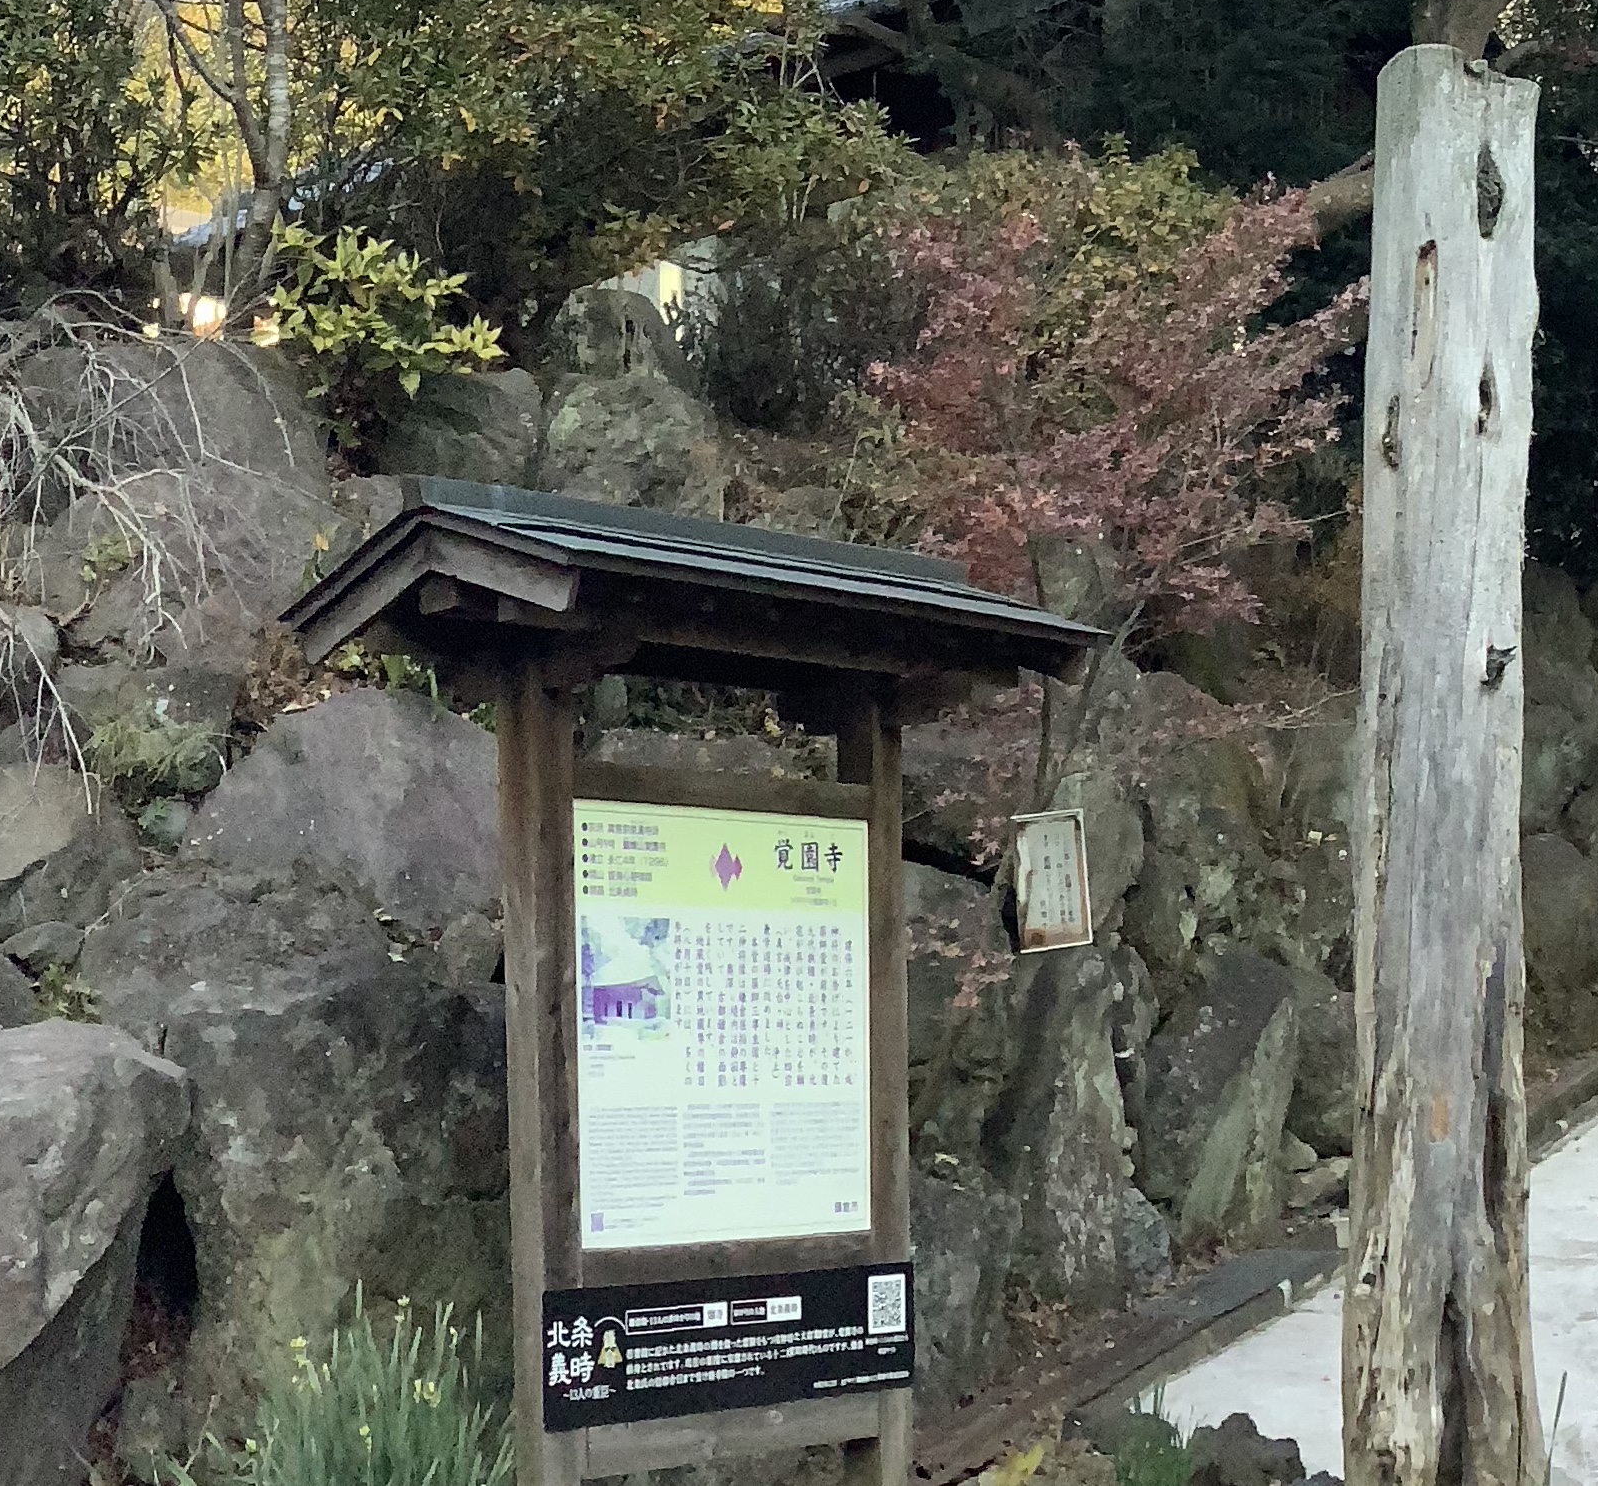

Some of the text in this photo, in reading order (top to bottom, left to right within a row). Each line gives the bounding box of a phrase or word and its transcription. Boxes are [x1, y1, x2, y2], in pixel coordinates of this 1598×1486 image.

[774, 838, 843, 873] 覚園寺
[547, 1316, 593, 1348] 北条
[548, 1350, 595, 1387] 義時
